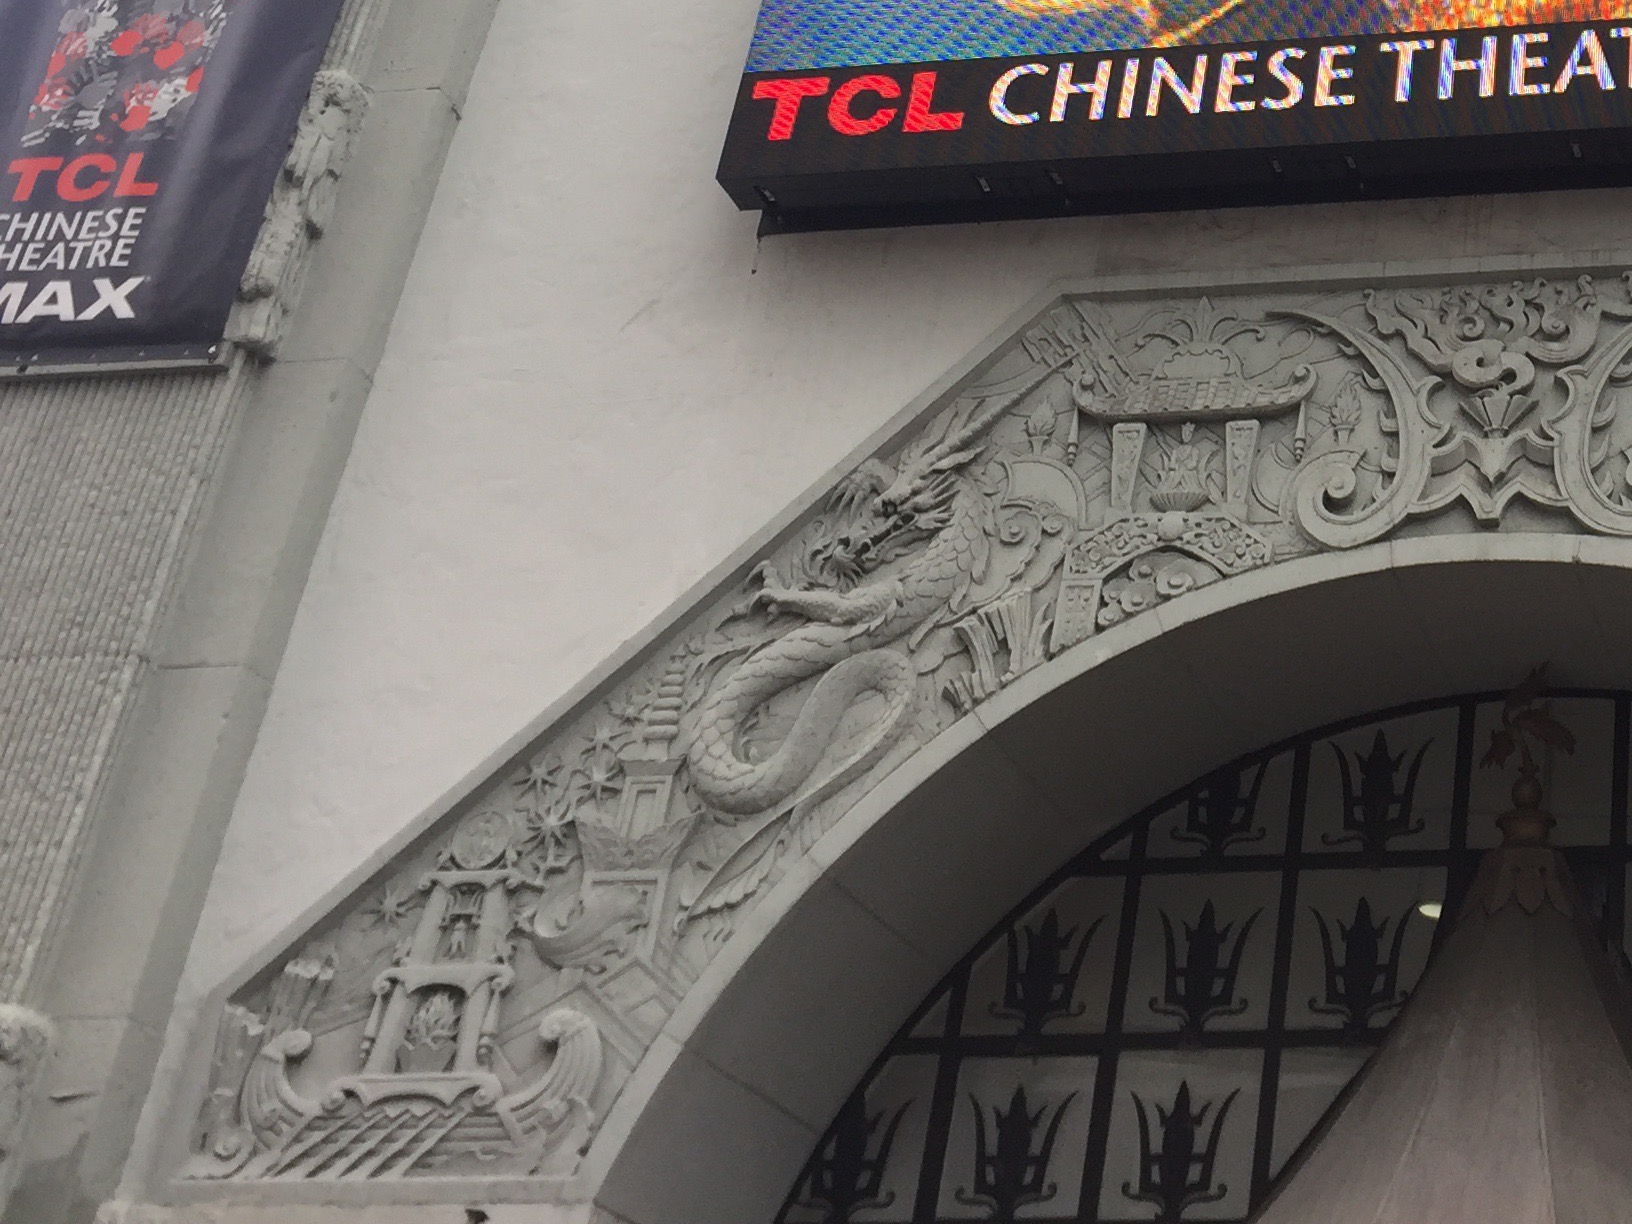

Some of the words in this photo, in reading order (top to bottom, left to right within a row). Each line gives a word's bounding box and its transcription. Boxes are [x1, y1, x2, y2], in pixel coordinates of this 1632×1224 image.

[752, 71, 965, 141] TCL
[988, 44, 1356, 126] CHINESE
[7, 152, 159, 203] TCL
[0, 206, 147, 242] HINESE
